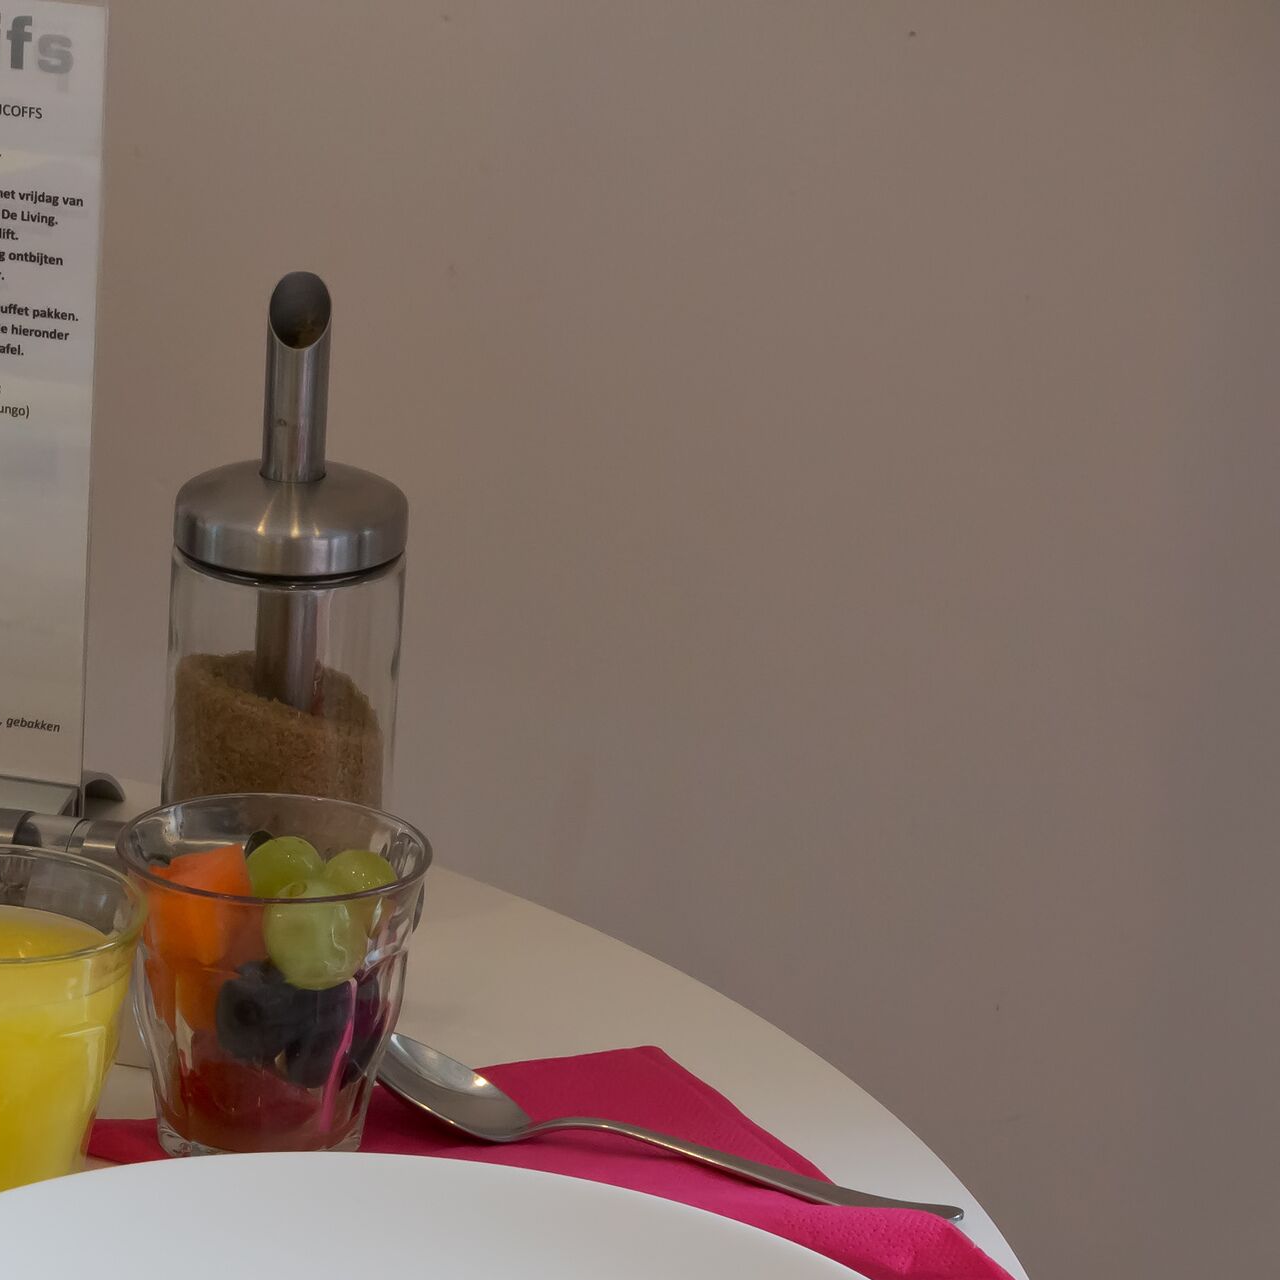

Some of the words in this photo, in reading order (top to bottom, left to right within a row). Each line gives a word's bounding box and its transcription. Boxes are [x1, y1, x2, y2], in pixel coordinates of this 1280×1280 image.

[17, 190, 60, 207] vrijdag
[61, 196, 84, 208] van
[1, 208, 18, 221] De
[20, 209, 59, 228] Living.
[7, 251, 64, 267] ontbijten
[31, 307, 79, 322] pakken.
[10, 323, 71, 339] hieronder
[5, 717, 61, 733] gebakken
